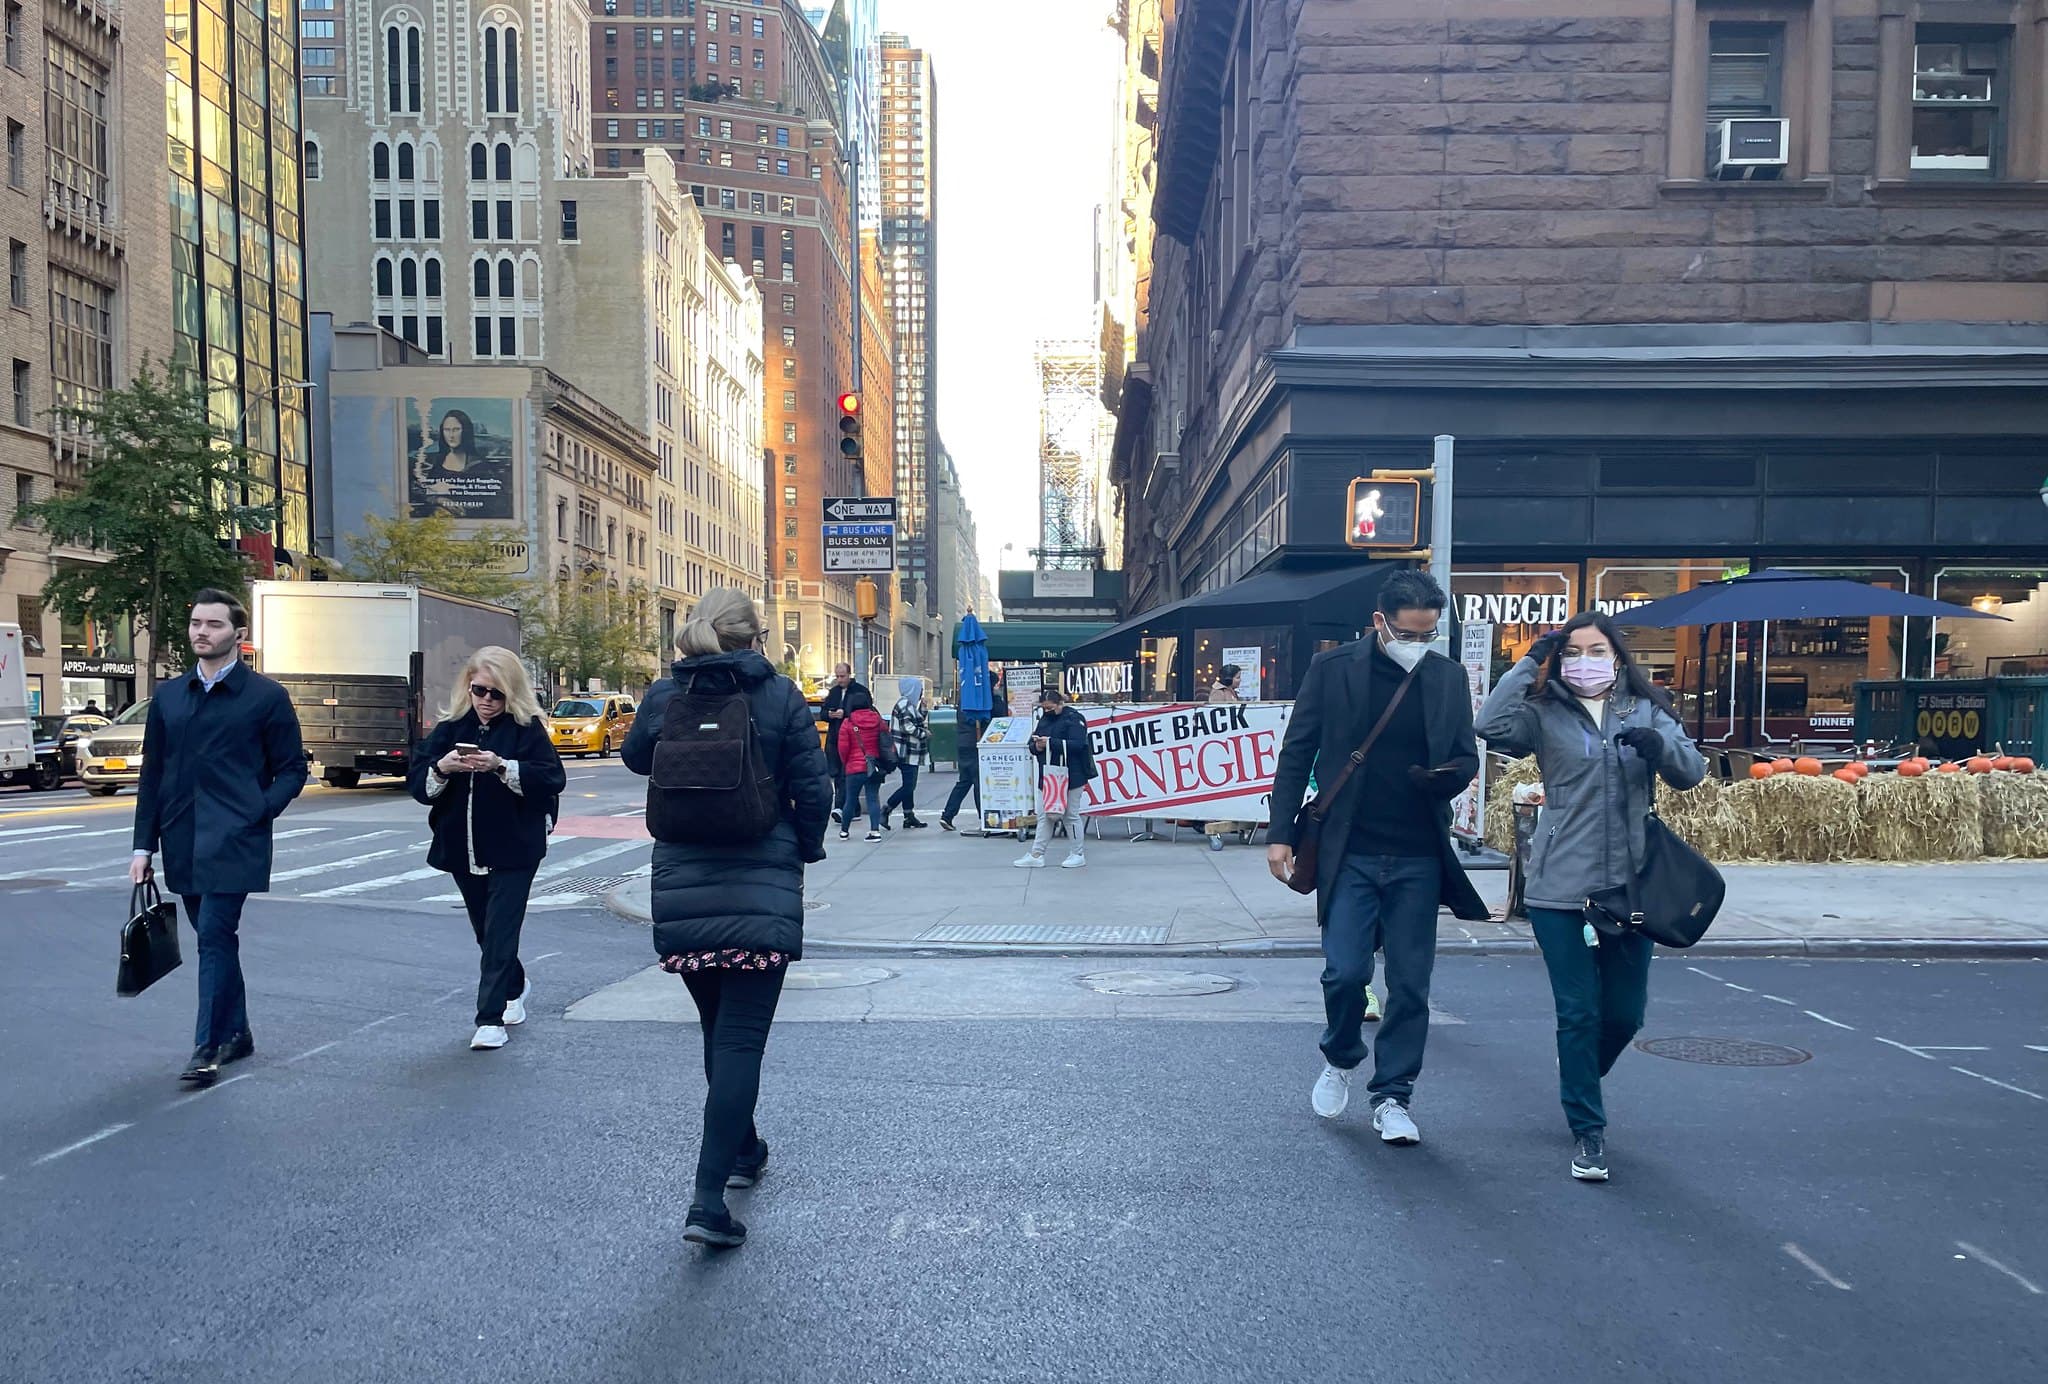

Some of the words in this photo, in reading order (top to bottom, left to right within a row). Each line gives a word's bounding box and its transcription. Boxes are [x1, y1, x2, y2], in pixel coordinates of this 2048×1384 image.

[834, 505, 855, 515] ONE
[864, 505, 887, 514] WAY
[842, 526, 860, 534] BUS
[863, 526, 887, 534] LANE
[828, 537, 860, 546] BUSES
[863, 537, 887, 545] ONLY
[1452, 593, 1570, 625] RNEGIE
[1040, 650, 1058, 658] The
[101, 663, 135, 675] APPRAISALS
[1918, 696, 1928, 708] 57
[1929, 696, 1954, 708] Street
[1956, 696, 1986, 708] Station
[1809, 717, 1855, 726] DINNER
[1966, 717, 1977, 733] W
[1087, 719, 1164, 756] COME
[1172, 703, 1249, 741] BACK
